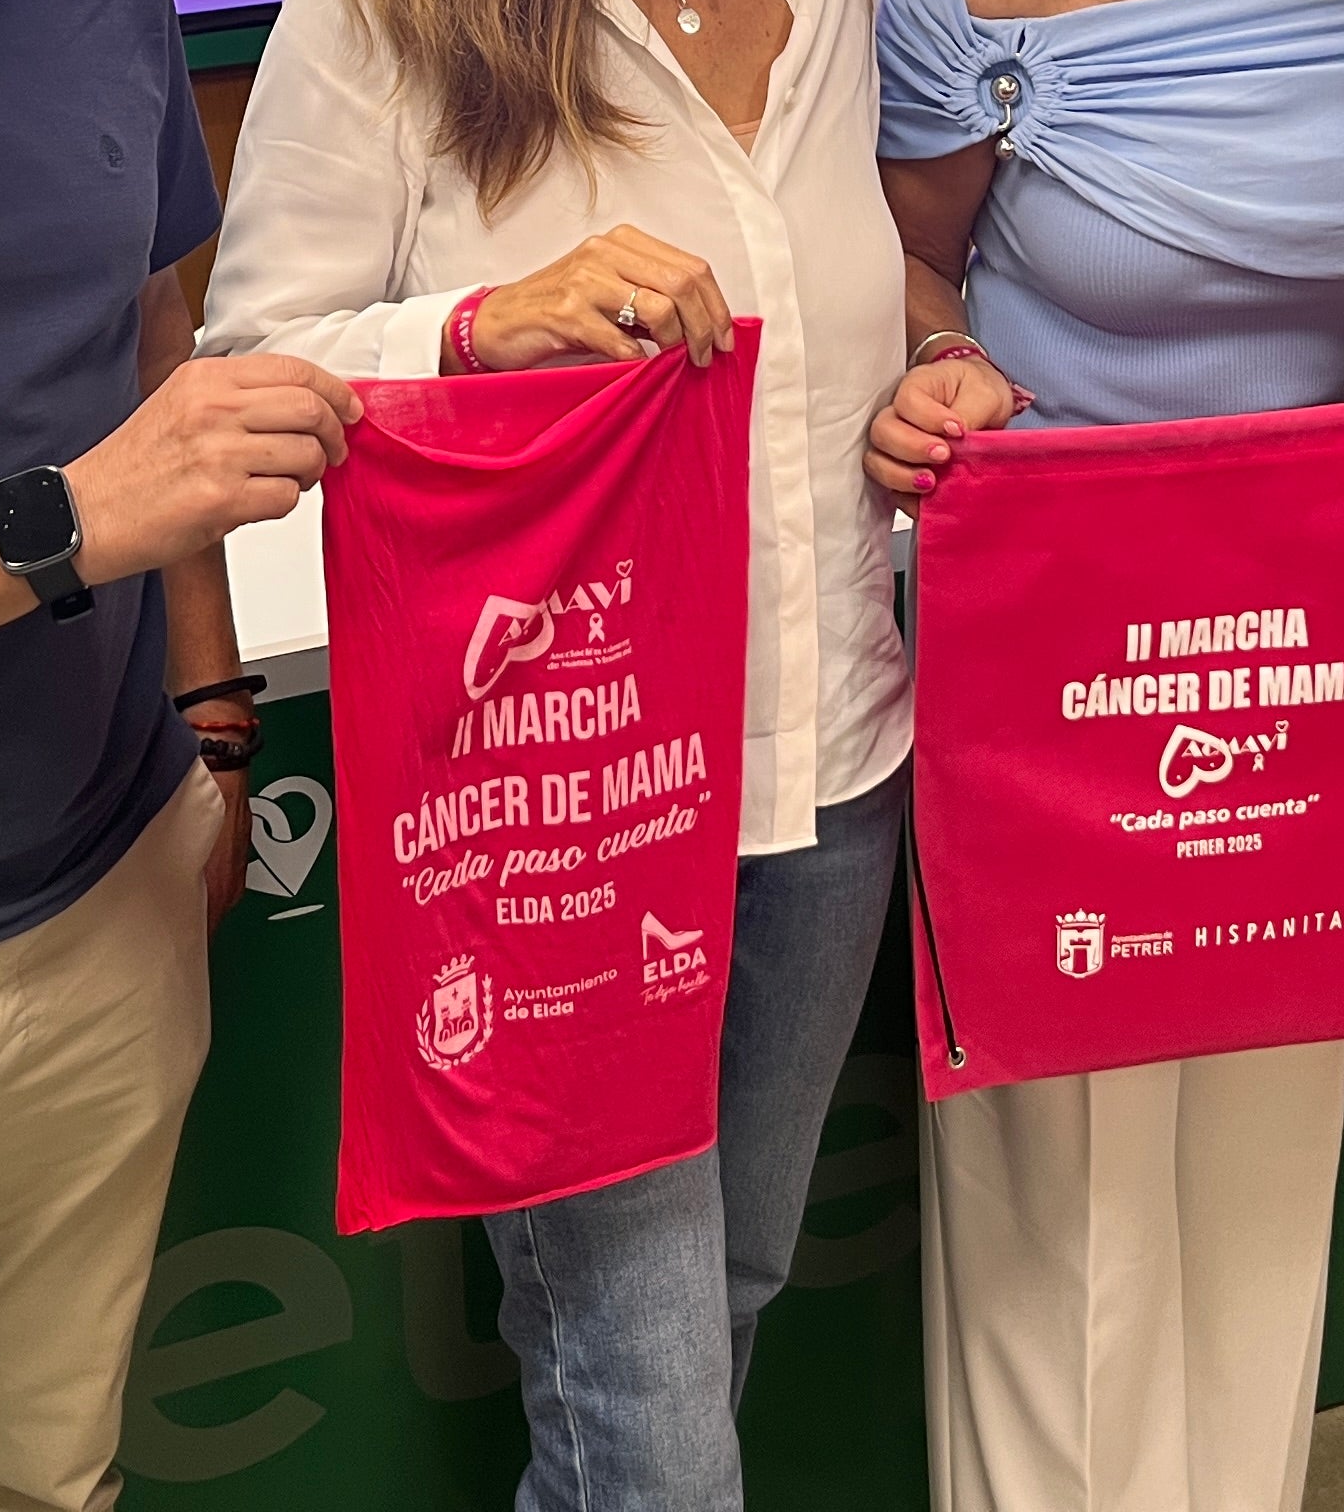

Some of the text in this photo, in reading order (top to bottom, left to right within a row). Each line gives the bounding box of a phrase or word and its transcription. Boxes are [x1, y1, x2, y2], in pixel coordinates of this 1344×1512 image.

[1125, 607, 1309, 662] II MARCHA
[1061, 673, 1200, 721] CÁNCER
[1208, 668, 1251, 712] DE
[451, 673, 642, 760] II MARCHA
[392, 732, 707, 865] CÁNCER DE MAMA
[1178, 807, 1231, 830] paso
[499, 843, 587, 888] paso
[1176, 833, 1263, 859] PETRER 2025
[496, 881, 617, 925] ELDA 2025
[643, 946, 707, 984] ELDA
[1110, 940, 1174, 958] PETRER
[503, 968, 619, 1005] Ayuntamiento
[503, 999, 575, 1021] de Elda
